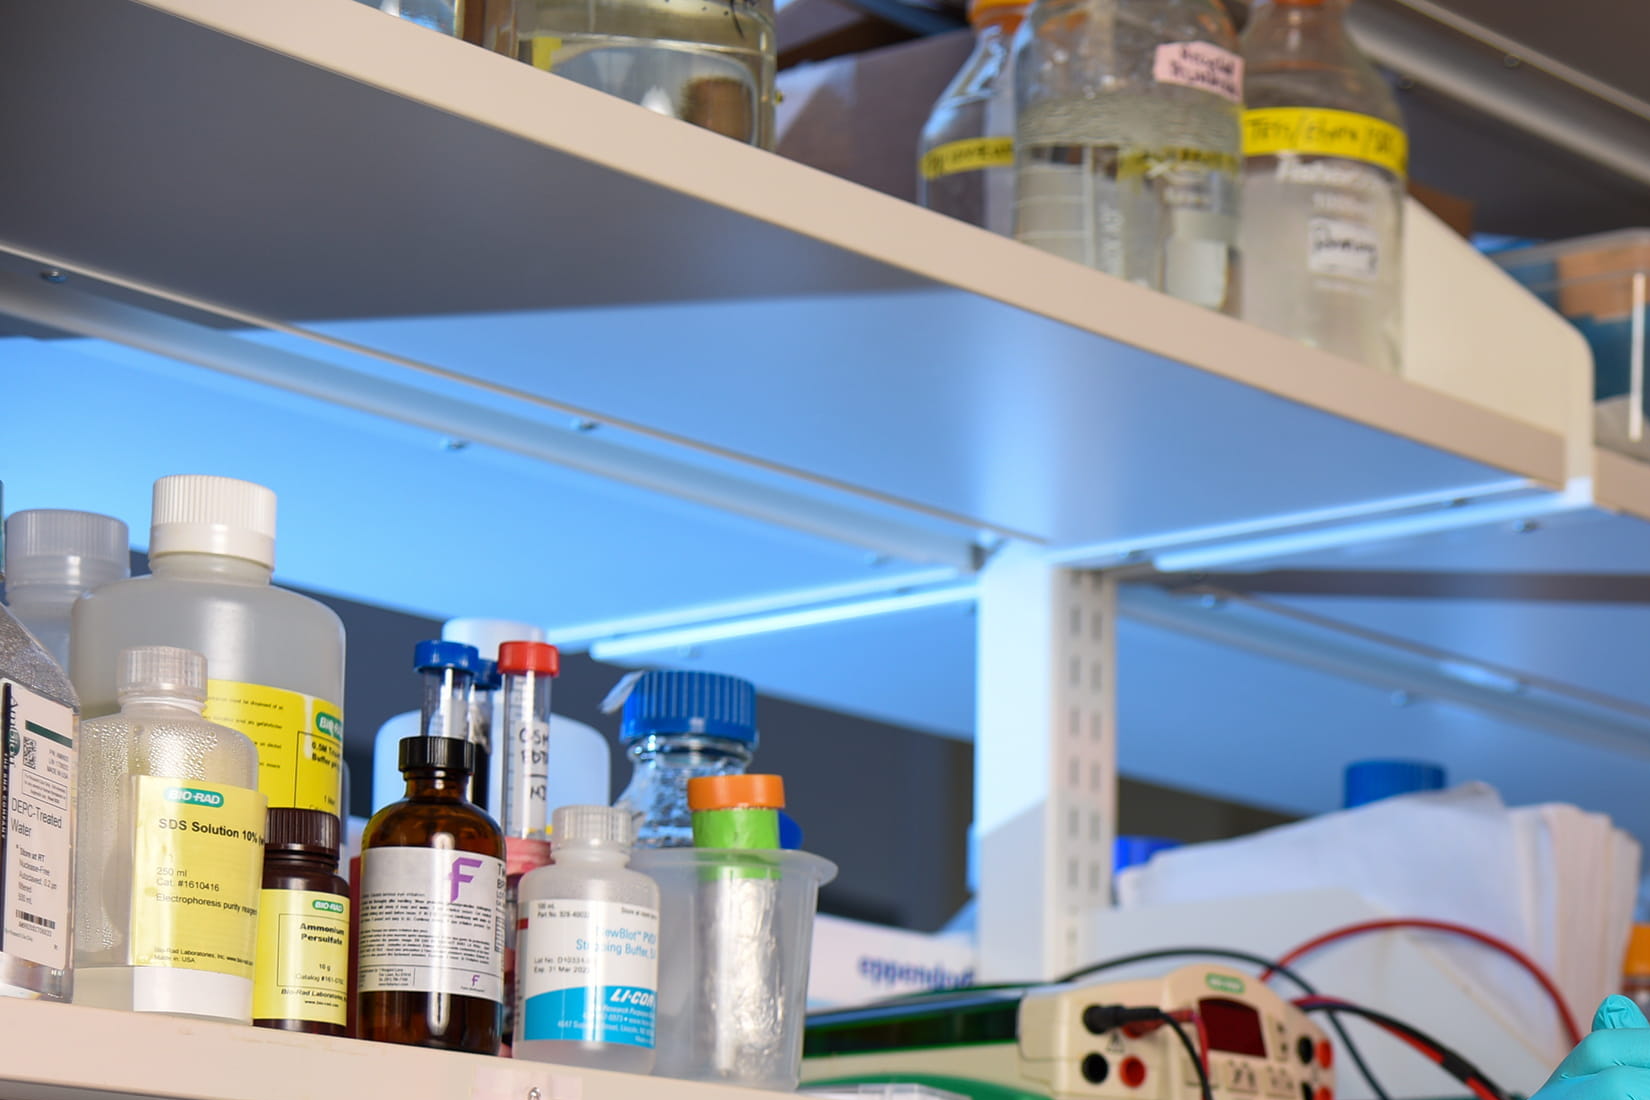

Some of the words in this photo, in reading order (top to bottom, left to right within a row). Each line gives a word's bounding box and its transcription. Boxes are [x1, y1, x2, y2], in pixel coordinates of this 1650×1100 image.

[12, 797, 62, 829] DEPC-Treated
[11, 817, 32, 837] Water
[159, 818, 187, 831] SDS
[192, 822, 239, 839] Solution
[242, 830, 258, 844] 10%
[156, 866, 173, 876] 250
[177, 867, 187, 878] ml
[178, 879, 220, 892] #1610416
[448, 857, 483, 903] F
[156, 893, 221, 908] Electrophoresis
[300, 922, 345, 935] Ammonium
[301, 933, 343, 945] Persulfate
